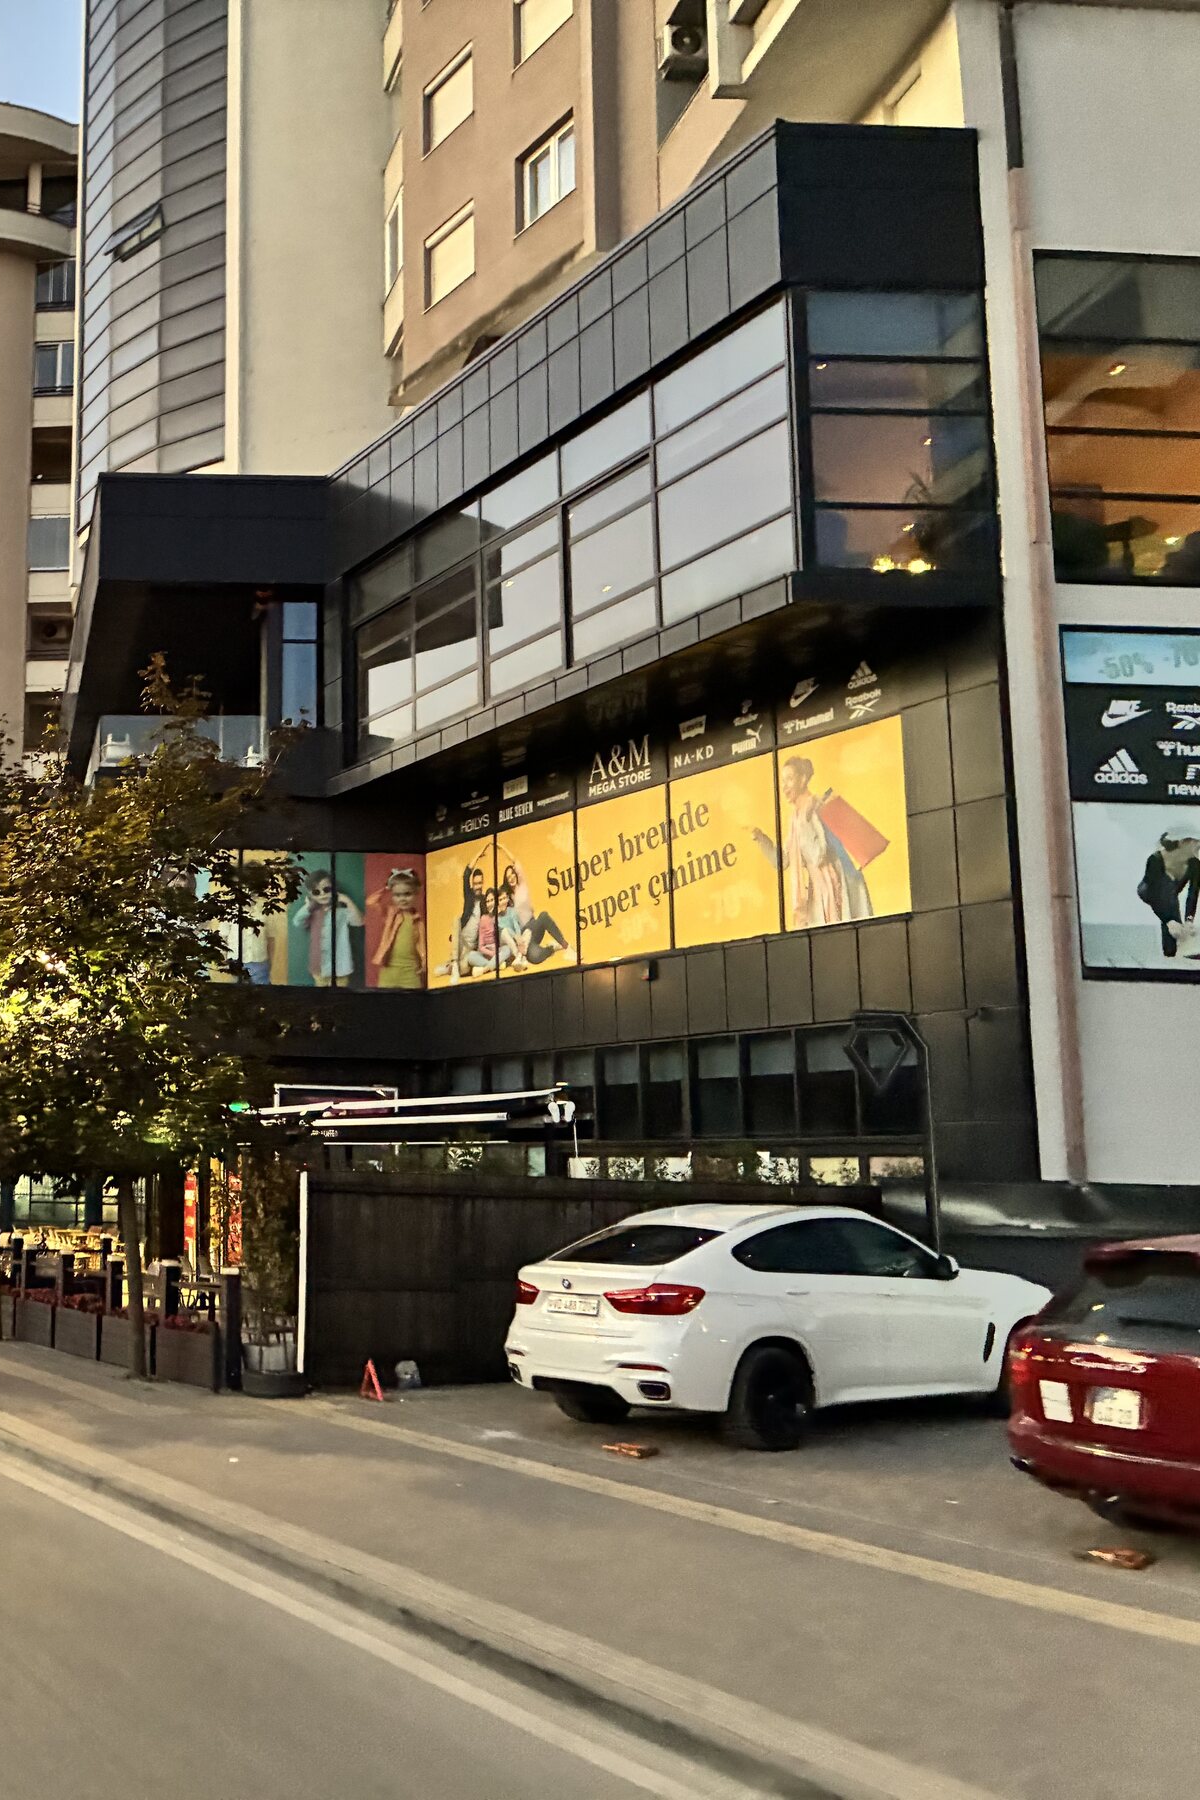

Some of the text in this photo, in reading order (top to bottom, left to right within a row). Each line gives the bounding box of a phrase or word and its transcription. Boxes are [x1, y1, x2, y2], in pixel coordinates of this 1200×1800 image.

[845, 688, 882, 706] Reebok
[796, 707, 834, 731] hummel
[588, 734, 651, 783] A&M
[588, 769, 651, 797] MEGA STORE
[1094, 773, 1148, 785] adidas
[1168, 784, 1200, 796] new
[499, 801, 534, 823] BLUE SEVEN
[546, 847, 614, 899] Super
[618, 800, 710, 863] brende
[578, 842, 738, 931] super çmime
